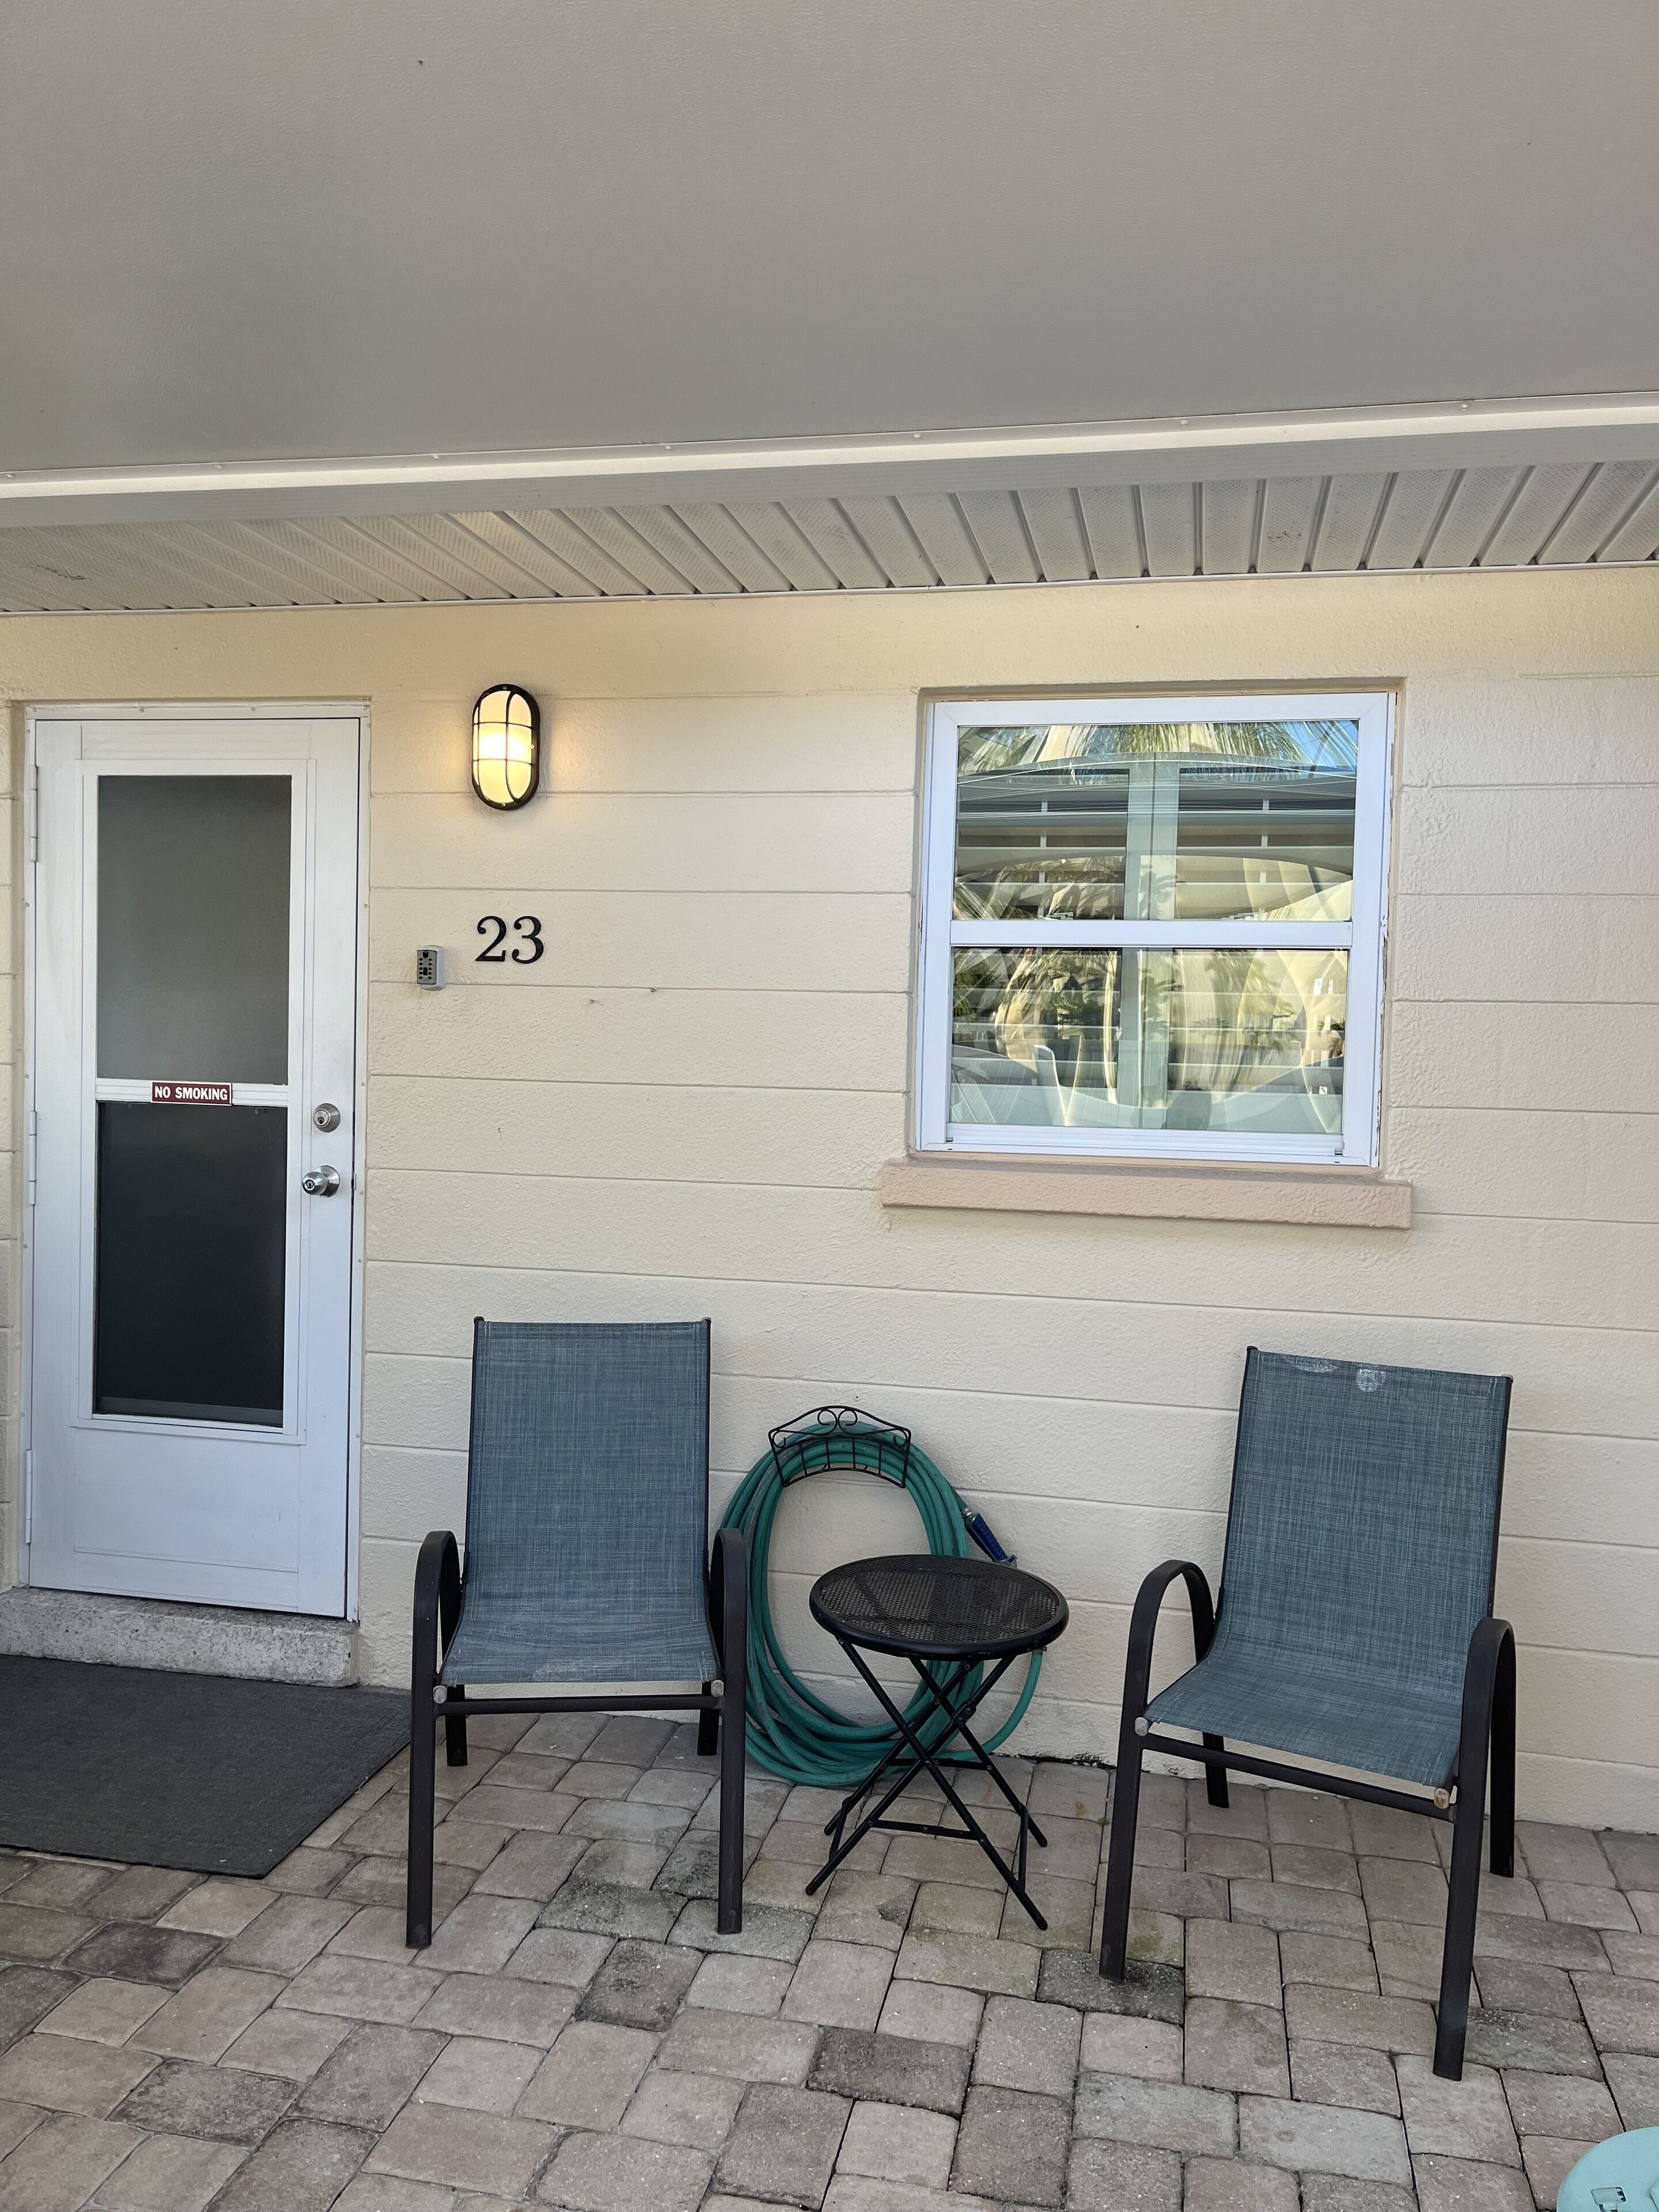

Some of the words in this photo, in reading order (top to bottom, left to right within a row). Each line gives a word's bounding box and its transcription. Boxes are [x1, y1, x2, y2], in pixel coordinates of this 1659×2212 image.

[475, 915, 544, 964] 23
[154, 1086, 171, 1099] NO
[175, 1086, 228, 1101] SMOKING
